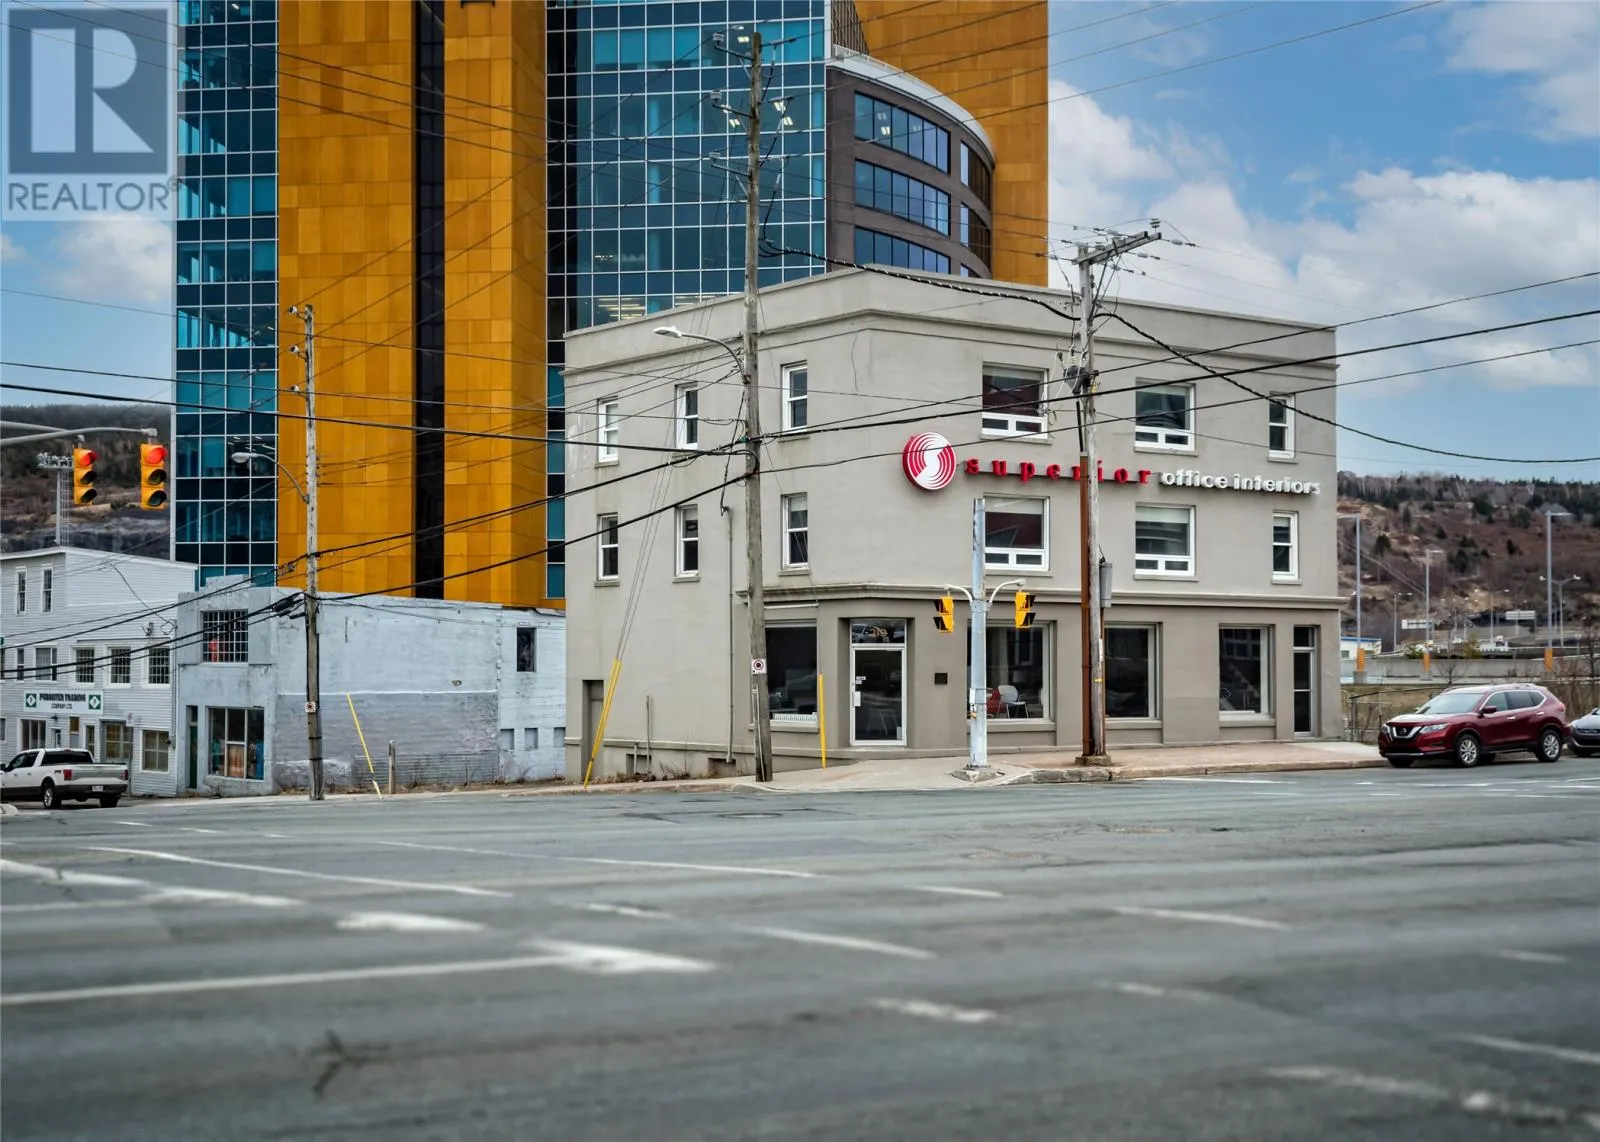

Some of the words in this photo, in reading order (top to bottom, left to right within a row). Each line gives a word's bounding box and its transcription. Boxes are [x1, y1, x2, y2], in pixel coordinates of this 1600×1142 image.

[965, 458, 1153, 484] superior
[1161, 469, 1228, 488] office
[1233, 473, 1321, 495] interiors
